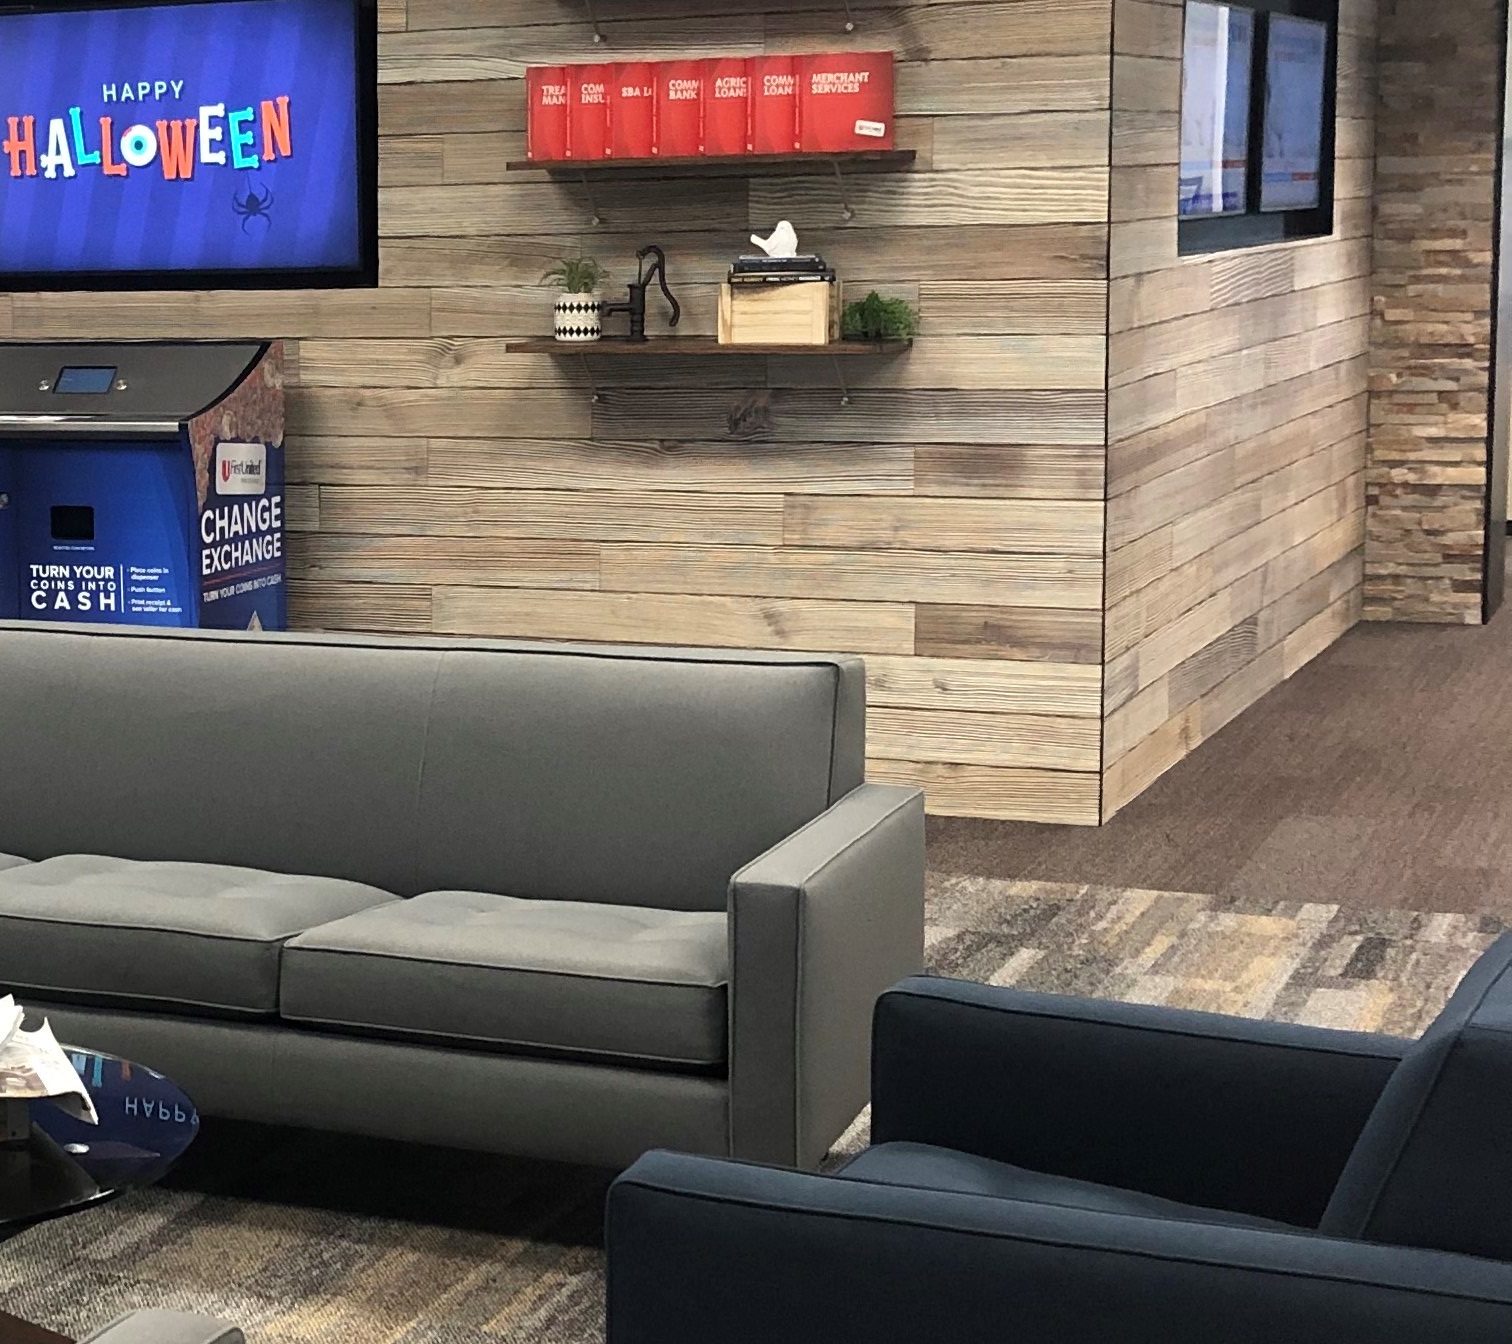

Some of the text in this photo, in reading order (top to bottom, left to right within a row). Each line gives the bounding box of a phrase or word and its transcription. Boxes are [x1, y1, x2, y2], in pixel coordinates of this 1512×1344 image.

[811, 71, 870, 84] MERCHANT
[811, 82, 860, 94] SERVICES
[102, 79, 185, 103] HAPPY
[621, 86, 641, 97] SBA
[2, 95, 293, 180] HALLOWEEN
[201, 495, 282, 544] CHANGE
[202, 532, 282, 575] EXCHANGE
[29, 564, 115, 579] TURN YOUR
[30, 579, 117, 592] COINS INTO
[203, 573, 282, 603] TURN YOUR COINS INTO CASH
[30, 590, 116, 612] CASH
